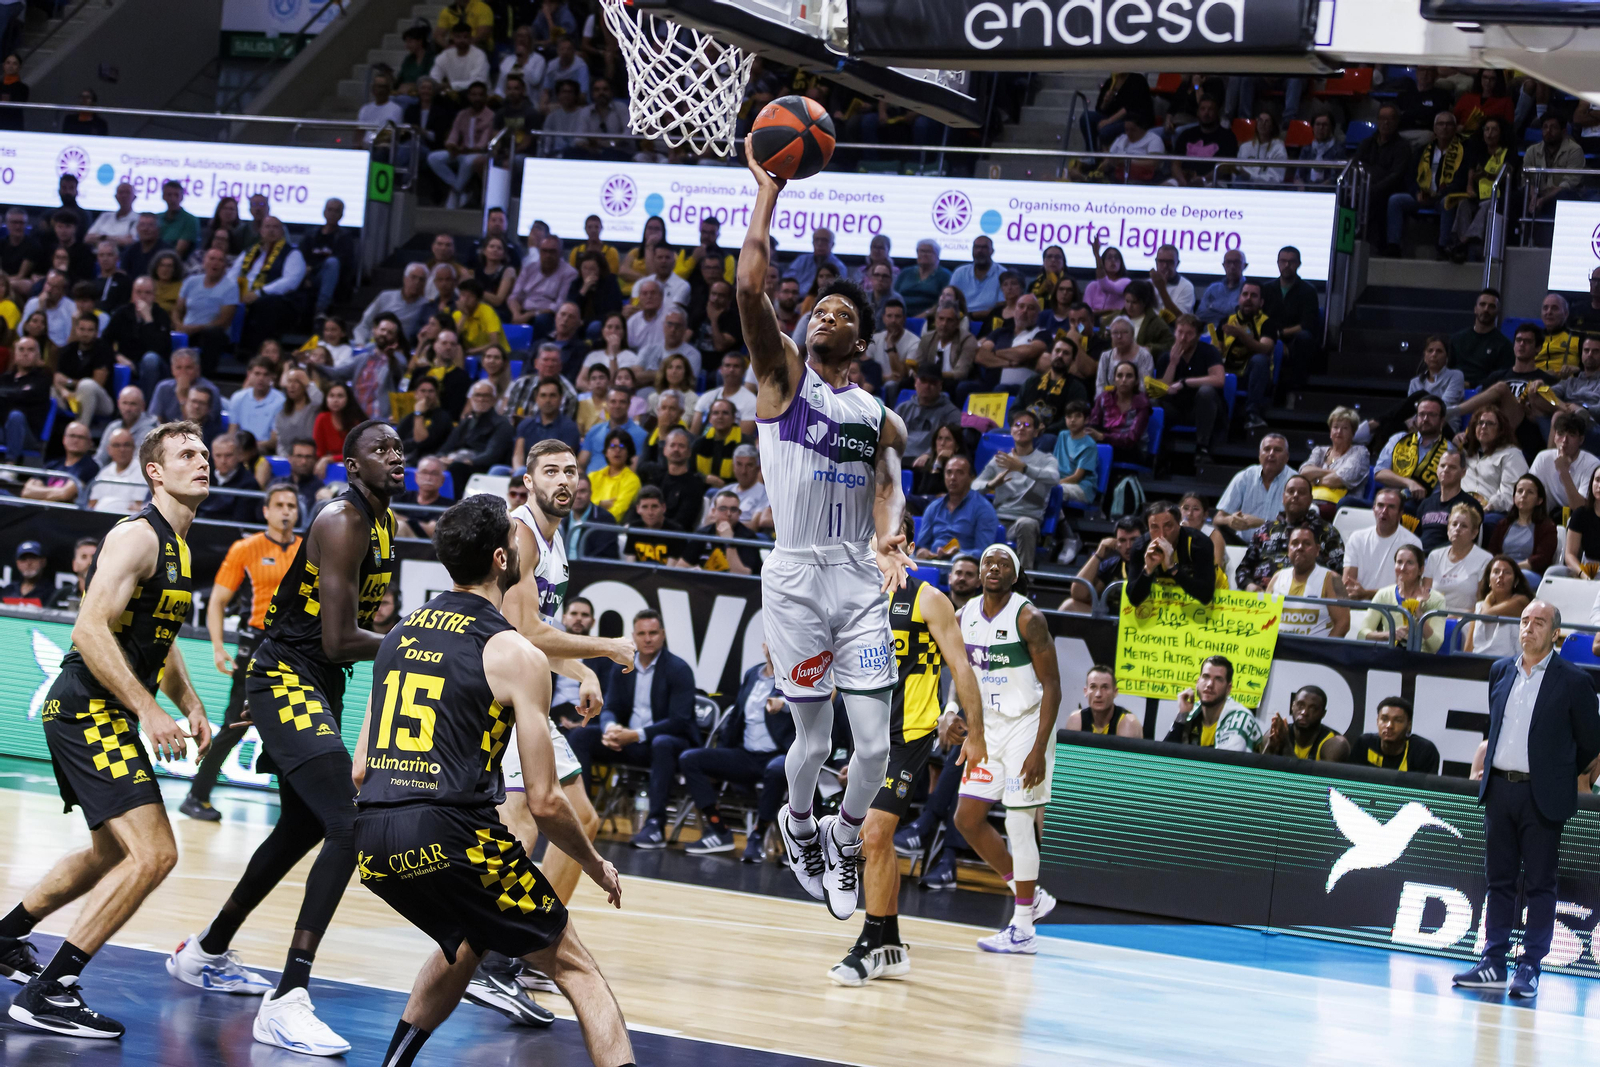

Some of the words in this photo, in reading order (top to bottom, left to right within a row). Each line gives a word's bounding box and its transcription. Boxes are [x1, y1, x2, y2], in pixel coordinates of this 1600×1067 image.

[120, 153, 180, 168] Organismo
[184, 157, 241, 171] Autónomo
[245, 160, 258, 173] de
[261, 162, 310, 176] Deportes
[670, 181, 737, 197] Organismo
[740, 185, 806, 200] Auomo
[809, 188, 825, 200] de
[828, 189, 885, 204] Deportes
[669, 197, 749, 231] deport
[1008, 197, 1080, 213] Organismo
[1084, 201, 1156, 217] Autónomo
[1160, 204, 1177, 217] de
[1181, 205, 1244, 221] Deportes
[1007, 213, 1110, 250] deporte
[1119, 218, 1242, 257] lagunero
[1343, 216, 1351, 243] P
[828, 432, 875, 458] Unicaja
[828, 502, 843, 538] 11
[402, 609, 476, 634] SASTRE
[1123, 627, 1179, 647] PROPONTE
[1184, 634, 1240, 655] ALCANZAR
[1245, 647, 1271, 660] UNAS
[1123, 646, 1159, 662] METAS
[1142, 665, 1175, 680] HASTA
[375, 670, 445, 752] 15
[390, 777, 410, 786] new
[411, 778, 439, 790] travel
[388, 843, 449, 874] CICAR
[415, 866, 437, 877] Islands
